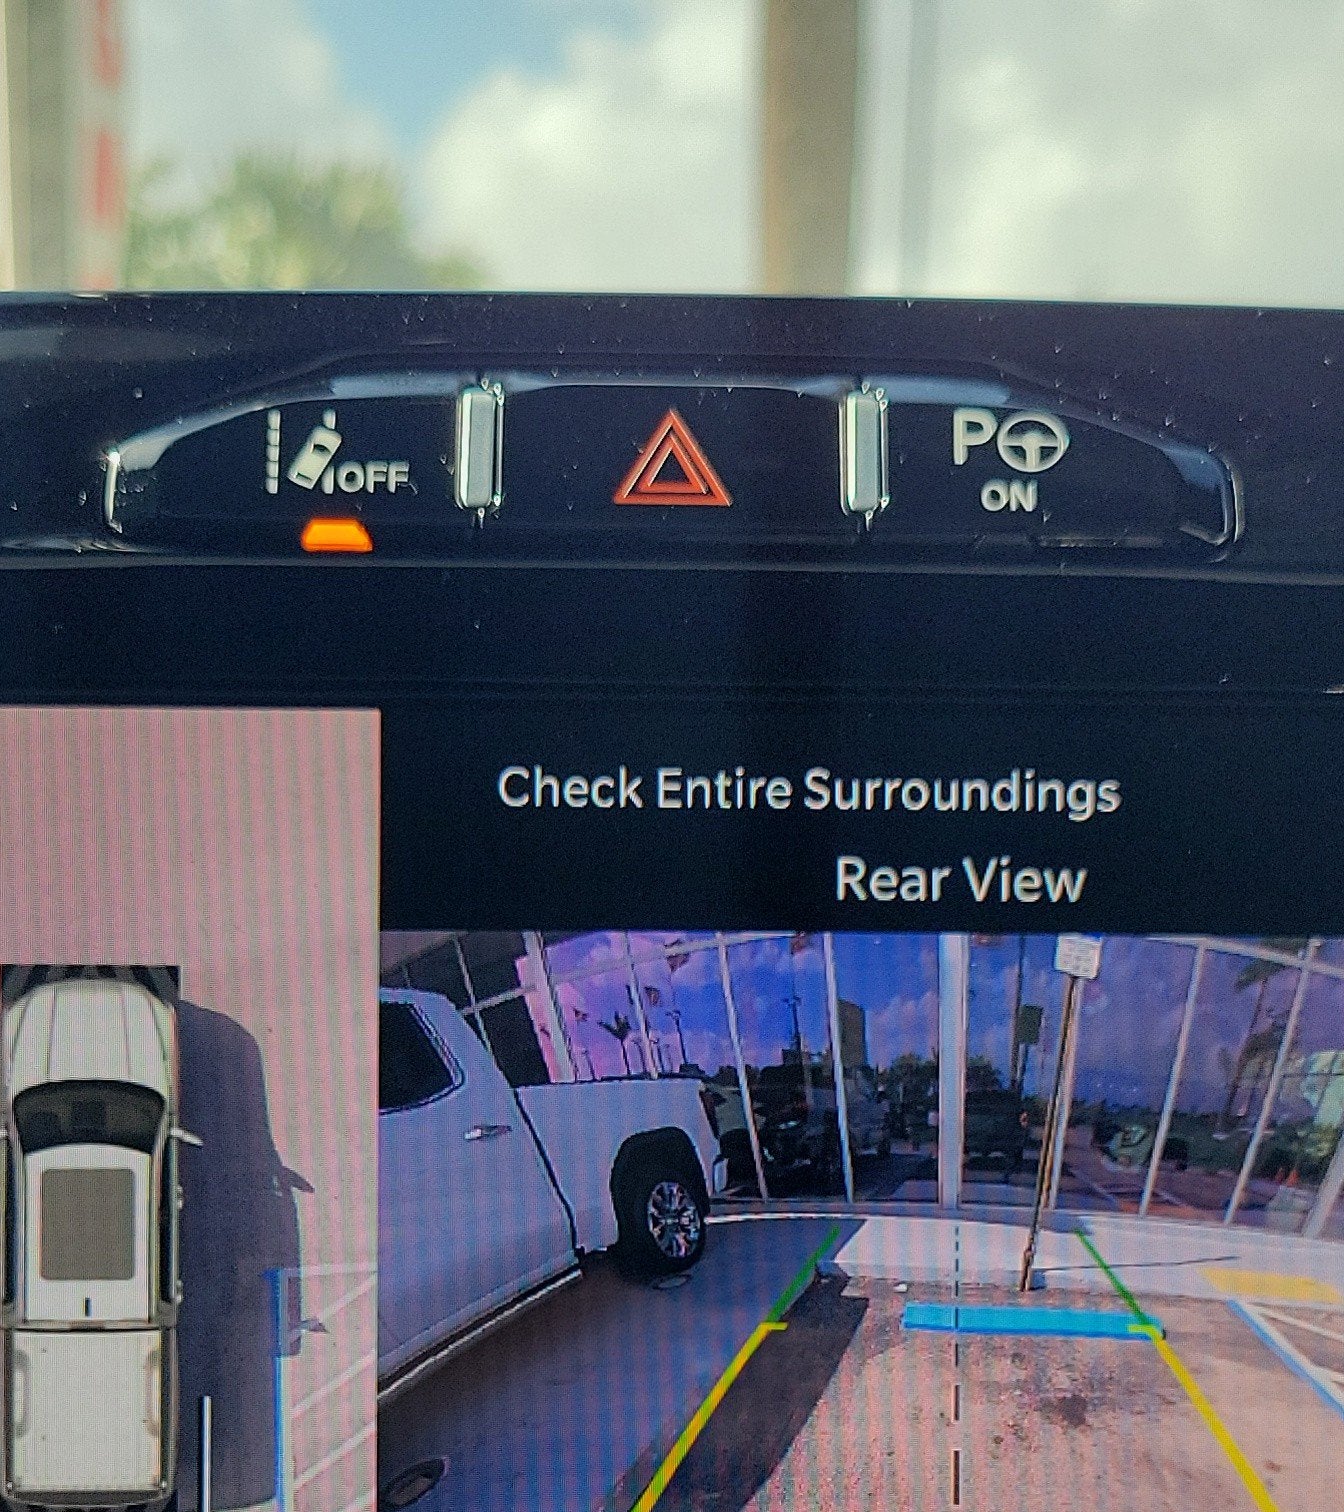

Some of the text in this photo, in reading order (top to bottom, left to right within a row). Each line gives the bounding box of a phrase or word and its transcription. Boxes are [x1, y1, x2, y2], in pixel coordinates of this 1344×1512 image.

[337, 463, 409, 493] OFF
[981, 481, 1037, 512] ON
[498, 765, 1121, 822] Check Entire Surroundings
[836, 855, 1087, 903] Rear View
